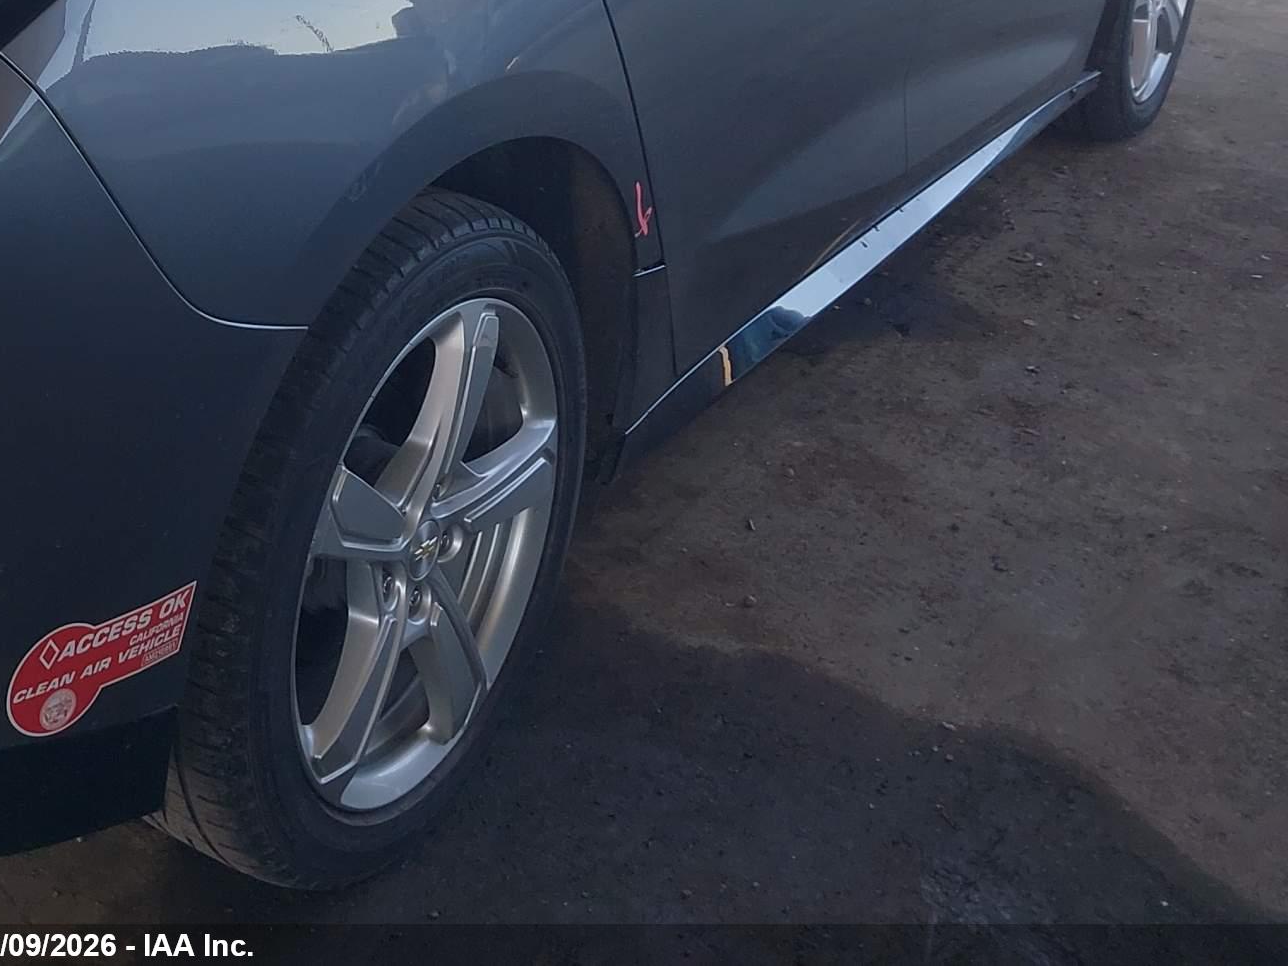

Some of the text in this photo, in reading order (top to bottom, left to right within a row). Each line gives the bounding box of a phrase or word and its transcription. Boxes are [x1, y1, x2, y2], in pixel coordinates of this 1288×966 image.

[58, 609, 153, 662] ACCESS
[159, 590, 189, 618] OK
[129, 612, 184, 646] CALIFORNIA
[13, 671, 76, 704] CLEAN
[80, 657, 112, 679] AIR
[118, 624, 182, 663] VEHICLE
